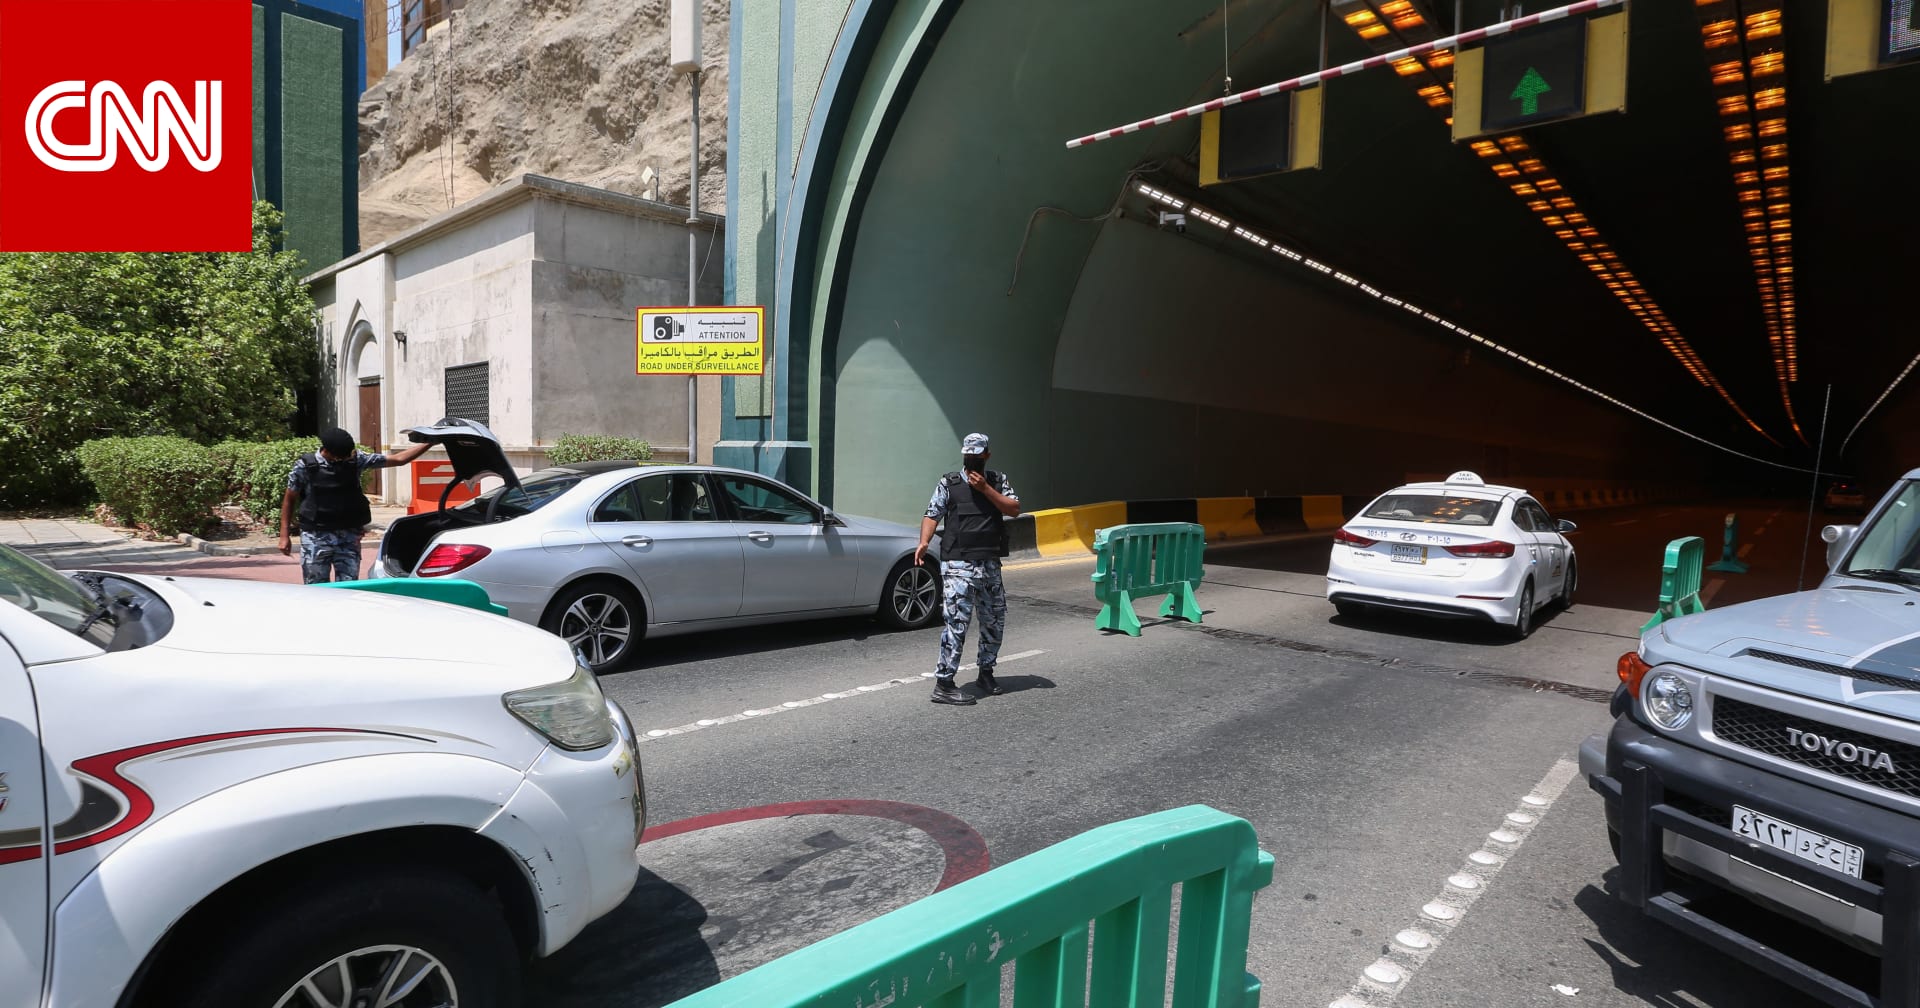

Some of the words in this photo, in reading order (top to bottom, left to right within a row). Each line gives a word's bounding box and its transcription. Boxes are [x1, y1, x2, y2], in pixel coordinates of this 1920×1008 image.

[699, 331, 746, 340] ATTENTION
[640, 347, 681, 359] بالكاميرا
[684, 346, 718, 359] مراقب
[721, 347, 760, 359] الطريق
[640, 362, 663, 370] ROAD
[666, 362, 693, 370] UNDER
[695, 362, 759, 371] SURVEILLANCE
[1786, 727, 1896, 774] TOYOTA
